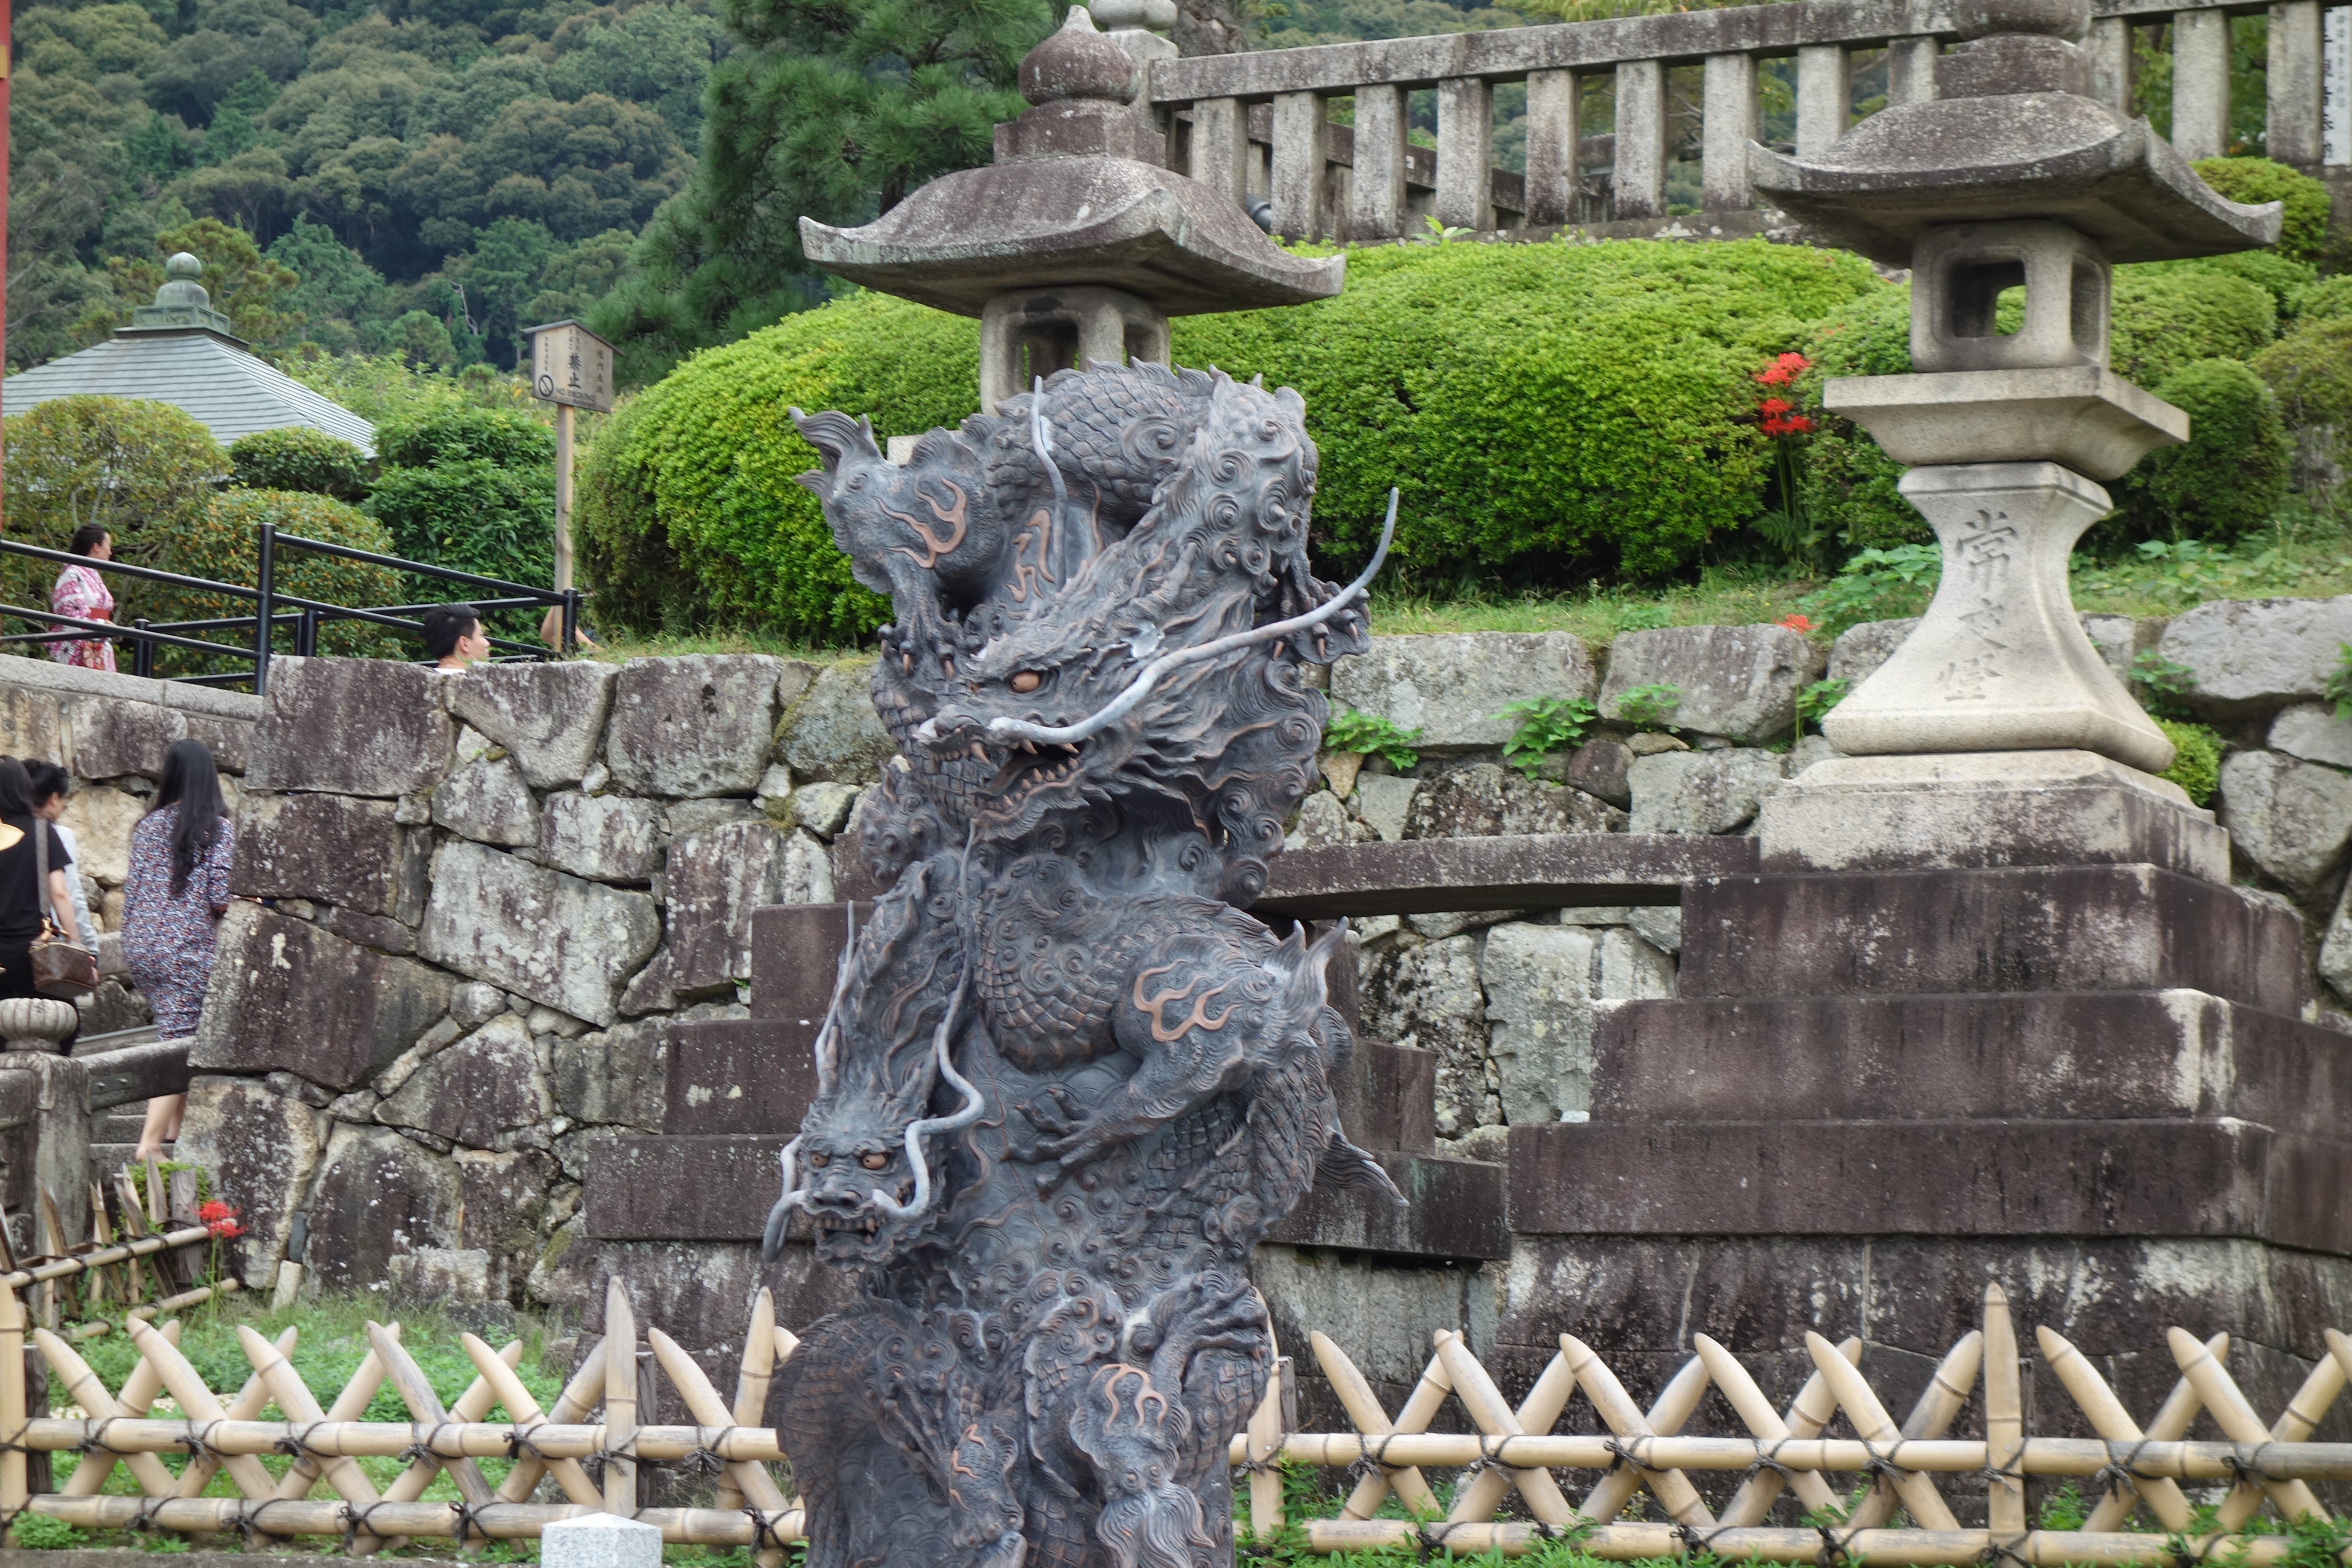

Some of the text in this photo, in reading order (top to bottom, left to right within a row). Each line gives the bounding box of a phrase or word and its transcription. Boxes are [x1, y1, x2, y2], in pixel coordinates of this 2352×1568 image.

[567, 352, 581, 389] 禁止
[556, 387, 595, 402] NO SMOKING
